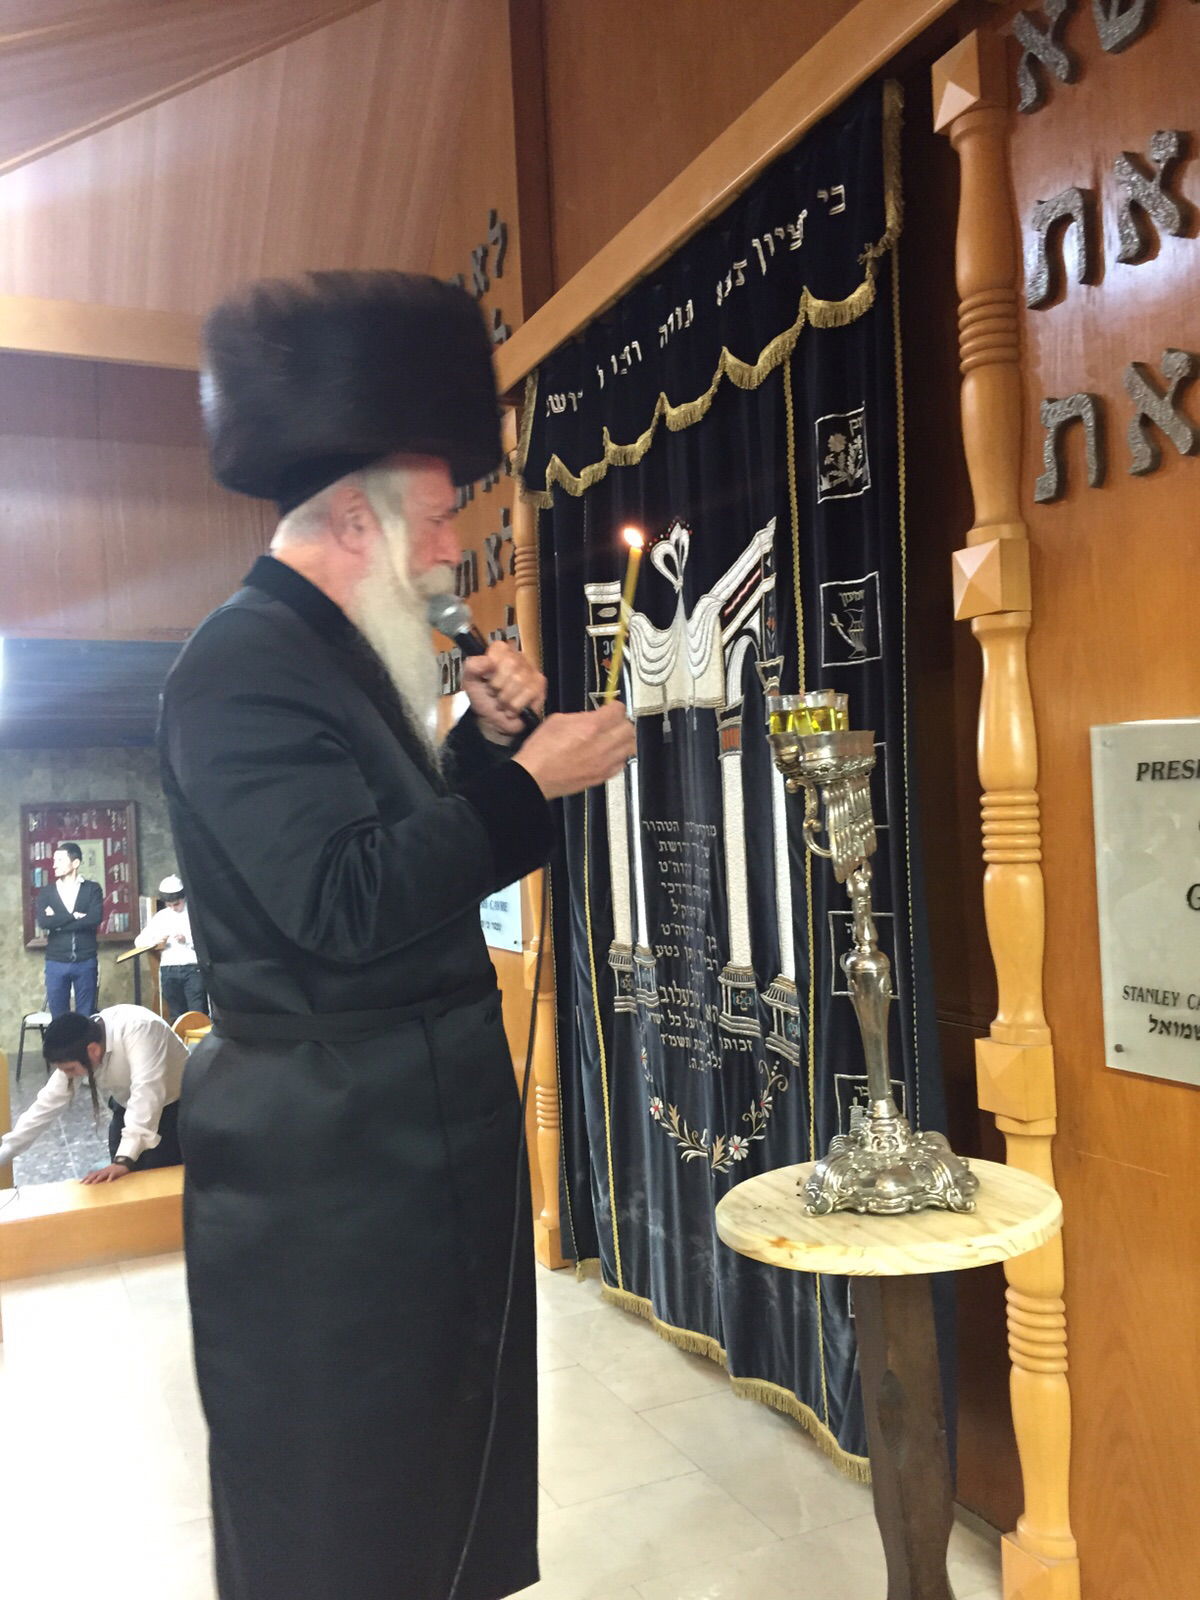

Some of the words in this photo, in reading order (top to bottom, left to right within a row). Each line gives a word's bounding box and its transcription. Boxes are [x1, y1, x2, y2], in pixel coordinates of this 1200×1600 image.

[816, 184, 846, 216] כי
[706, 935, 718, 953] בן
[1122, 984, 1181, 1007] STANLEY
